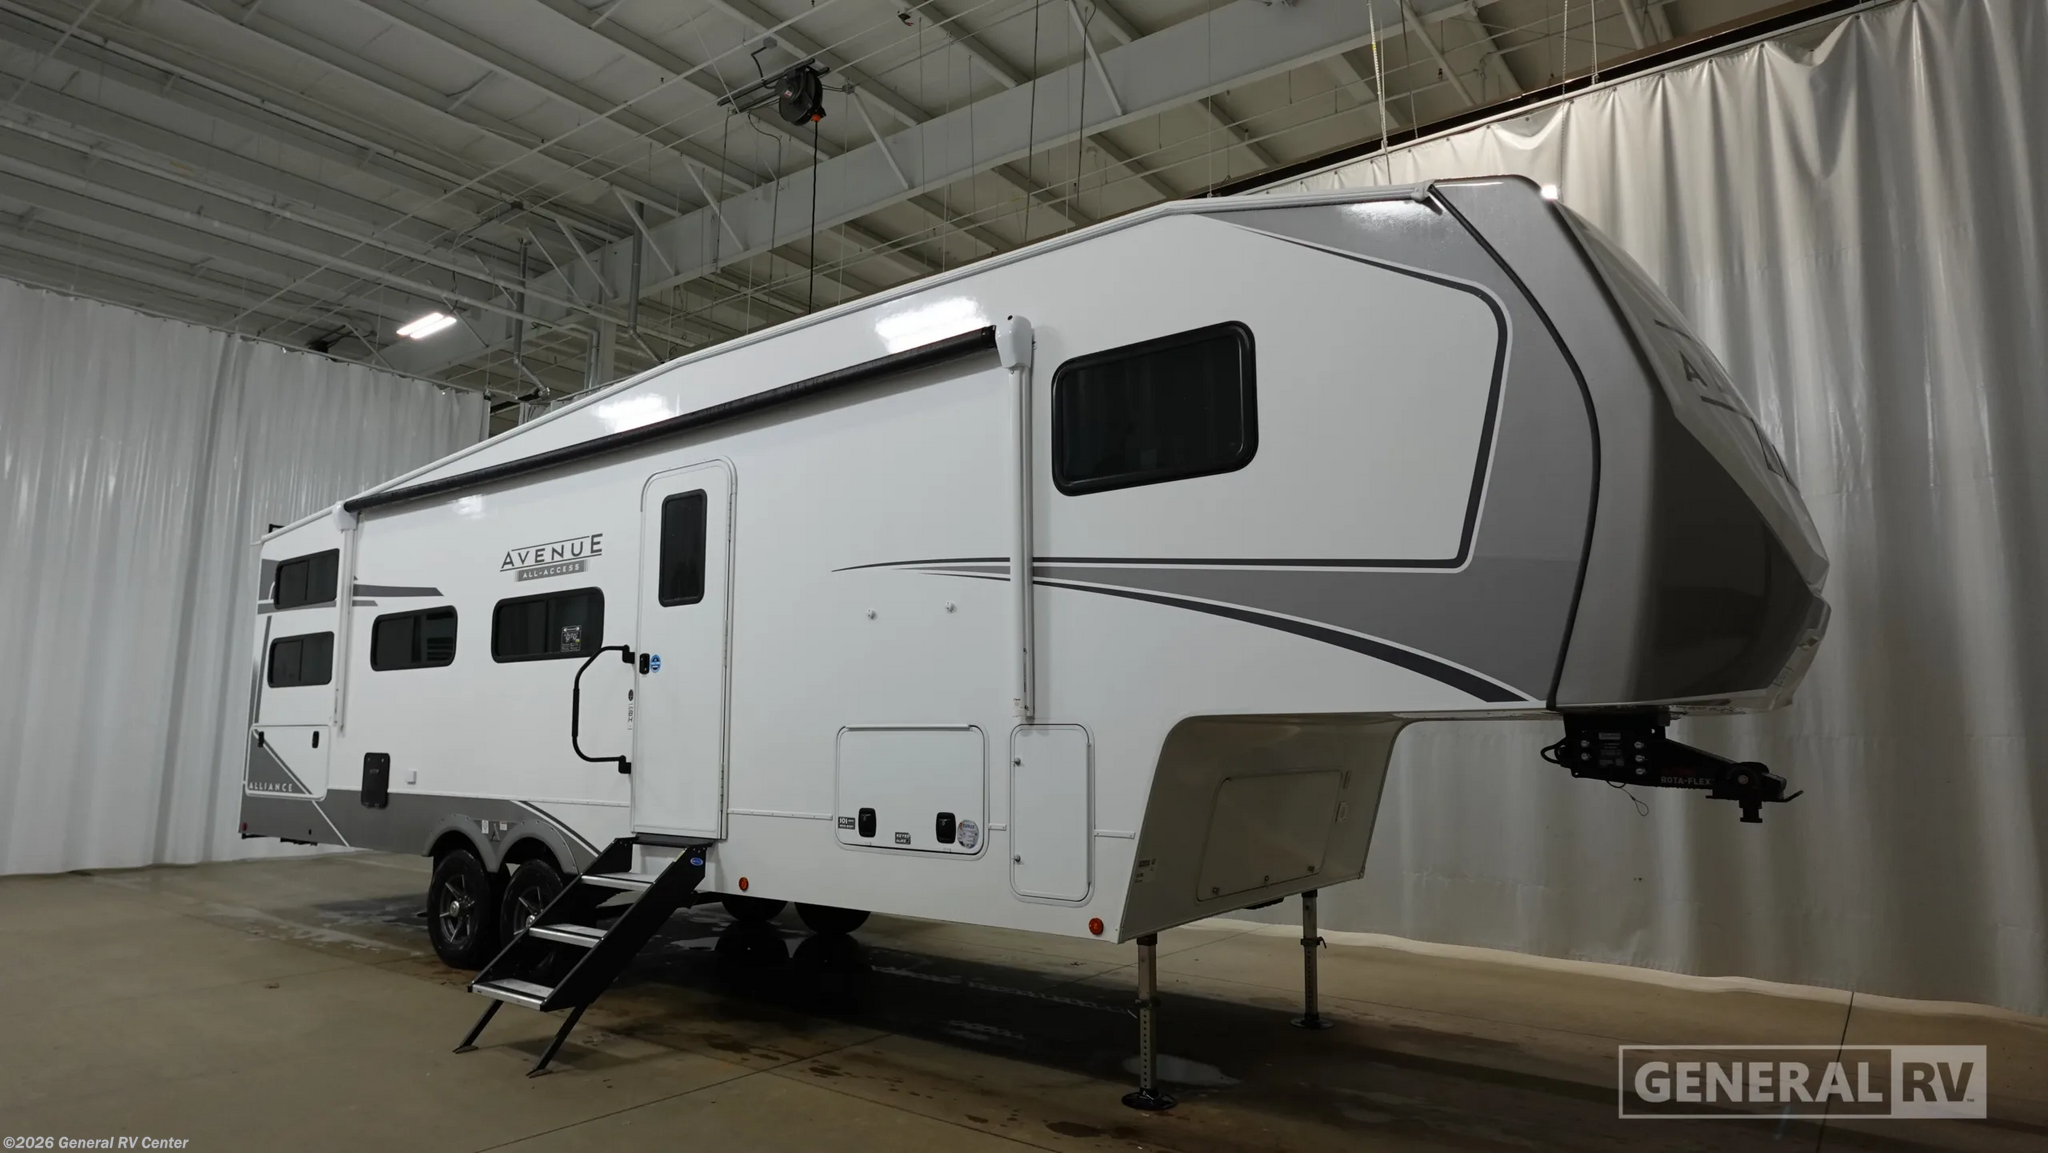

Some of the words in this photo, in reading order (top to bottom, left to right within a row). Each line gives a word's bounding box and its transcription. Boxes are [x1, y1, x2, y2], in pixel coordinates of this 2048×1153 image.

[500, 533, 603, 570] AVENUE
[522, 563, 580, 579] ALL-ACCESS
[249, 781, 293, 792] ALLIANCE
[1660, 776, 1712, 786] ROTA-FLEX
